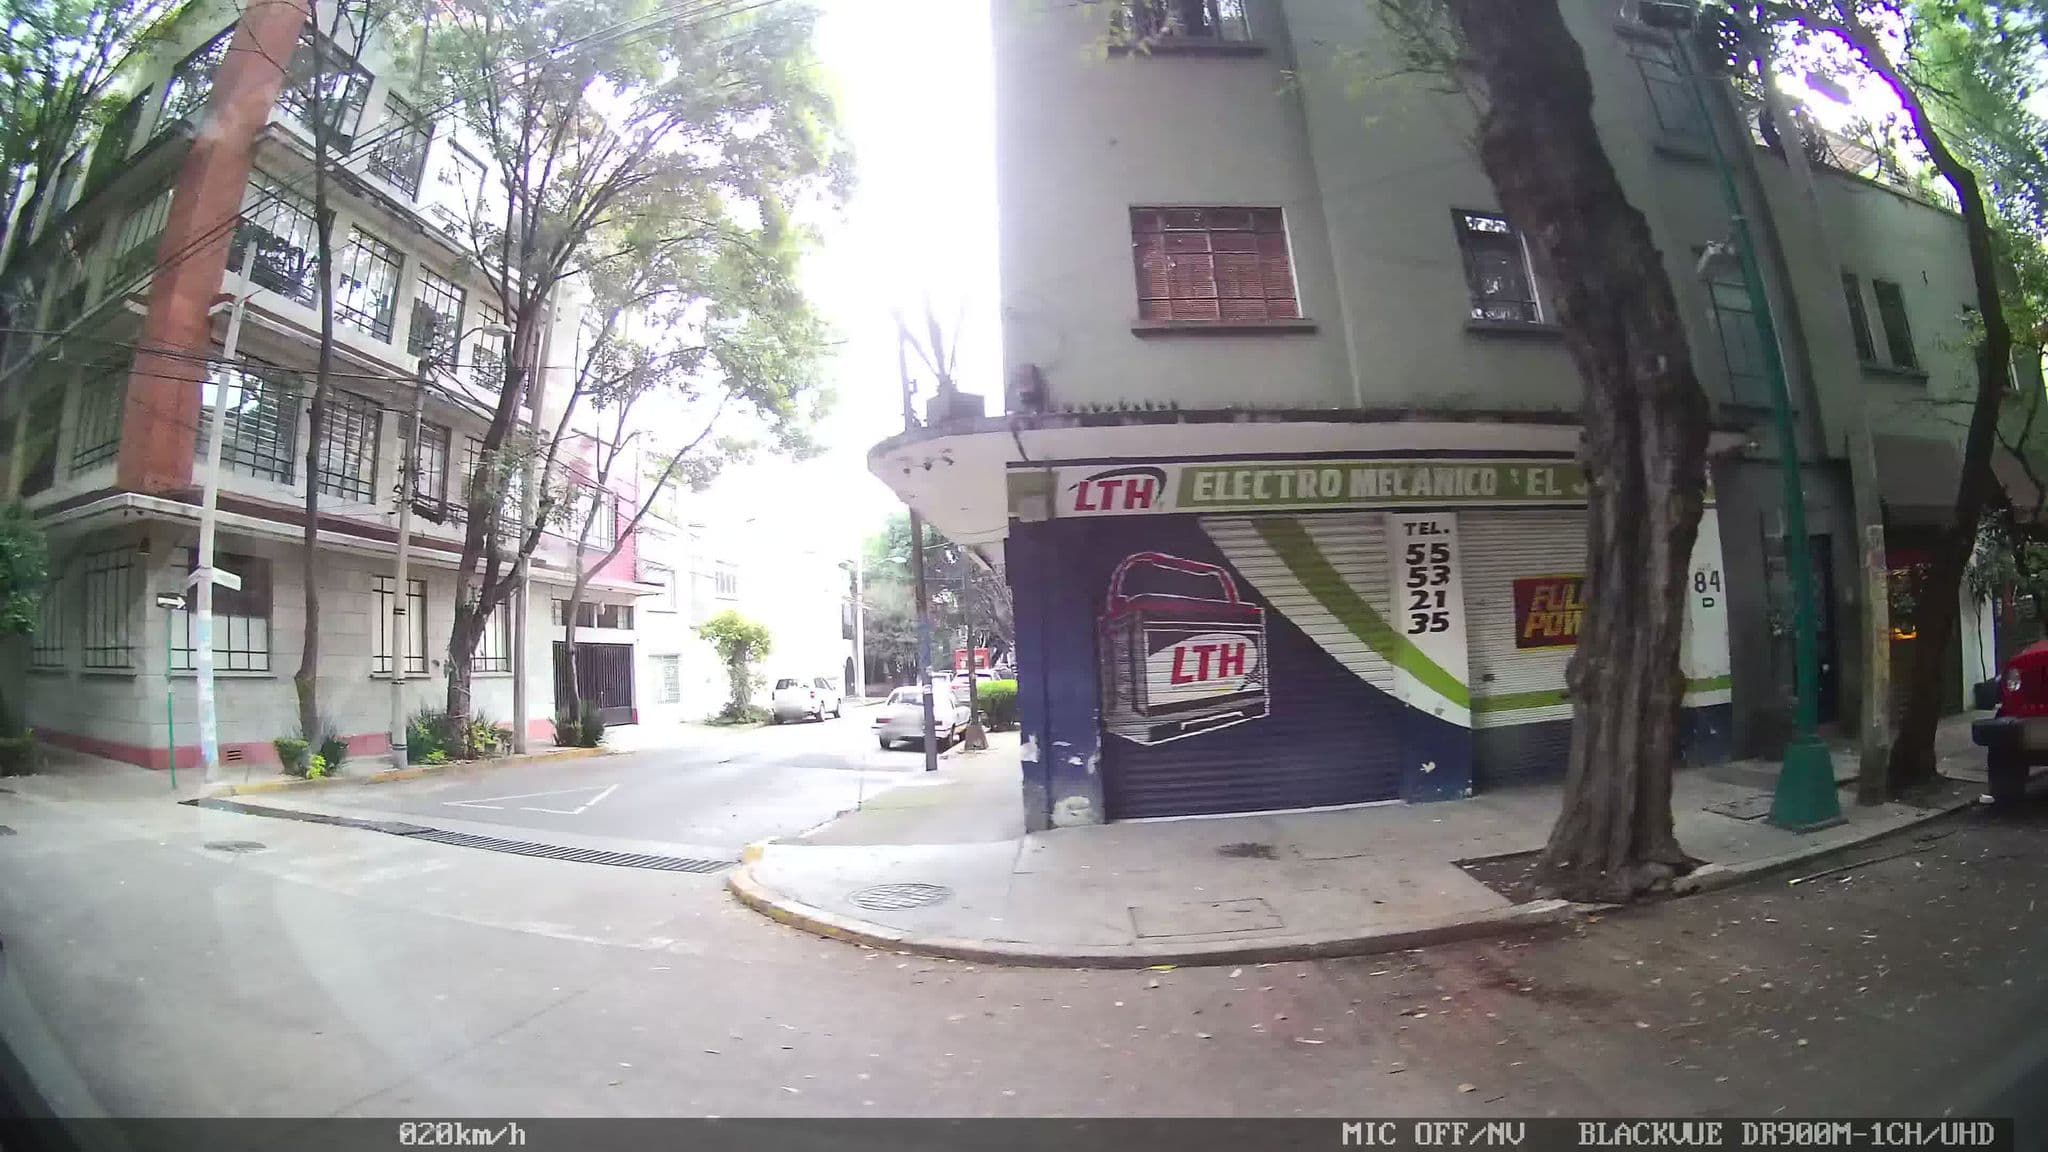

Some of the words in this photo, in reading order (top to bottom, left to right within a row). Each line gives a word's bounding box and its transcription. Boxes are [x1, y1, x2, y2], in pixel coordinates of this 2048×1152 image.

[1074, 478, 1155, 511] LTH
[1193, 469, 1343, 501] ELECTRO
[1403, 521, 1450, 536] TEL.
[1405, 543, 1450, 565] 55
[1406, 565, 1450, 588] 53
[1694, 570, 1720, 593] 84
[1408, 590, 1447, 611] 21
[1530, 584, 1585, 611] FUL
[1408, 611, 1449, 635] 35
[1523, 610, 1583, 639] POW
[1171, 643, 1246, 685] LTH
